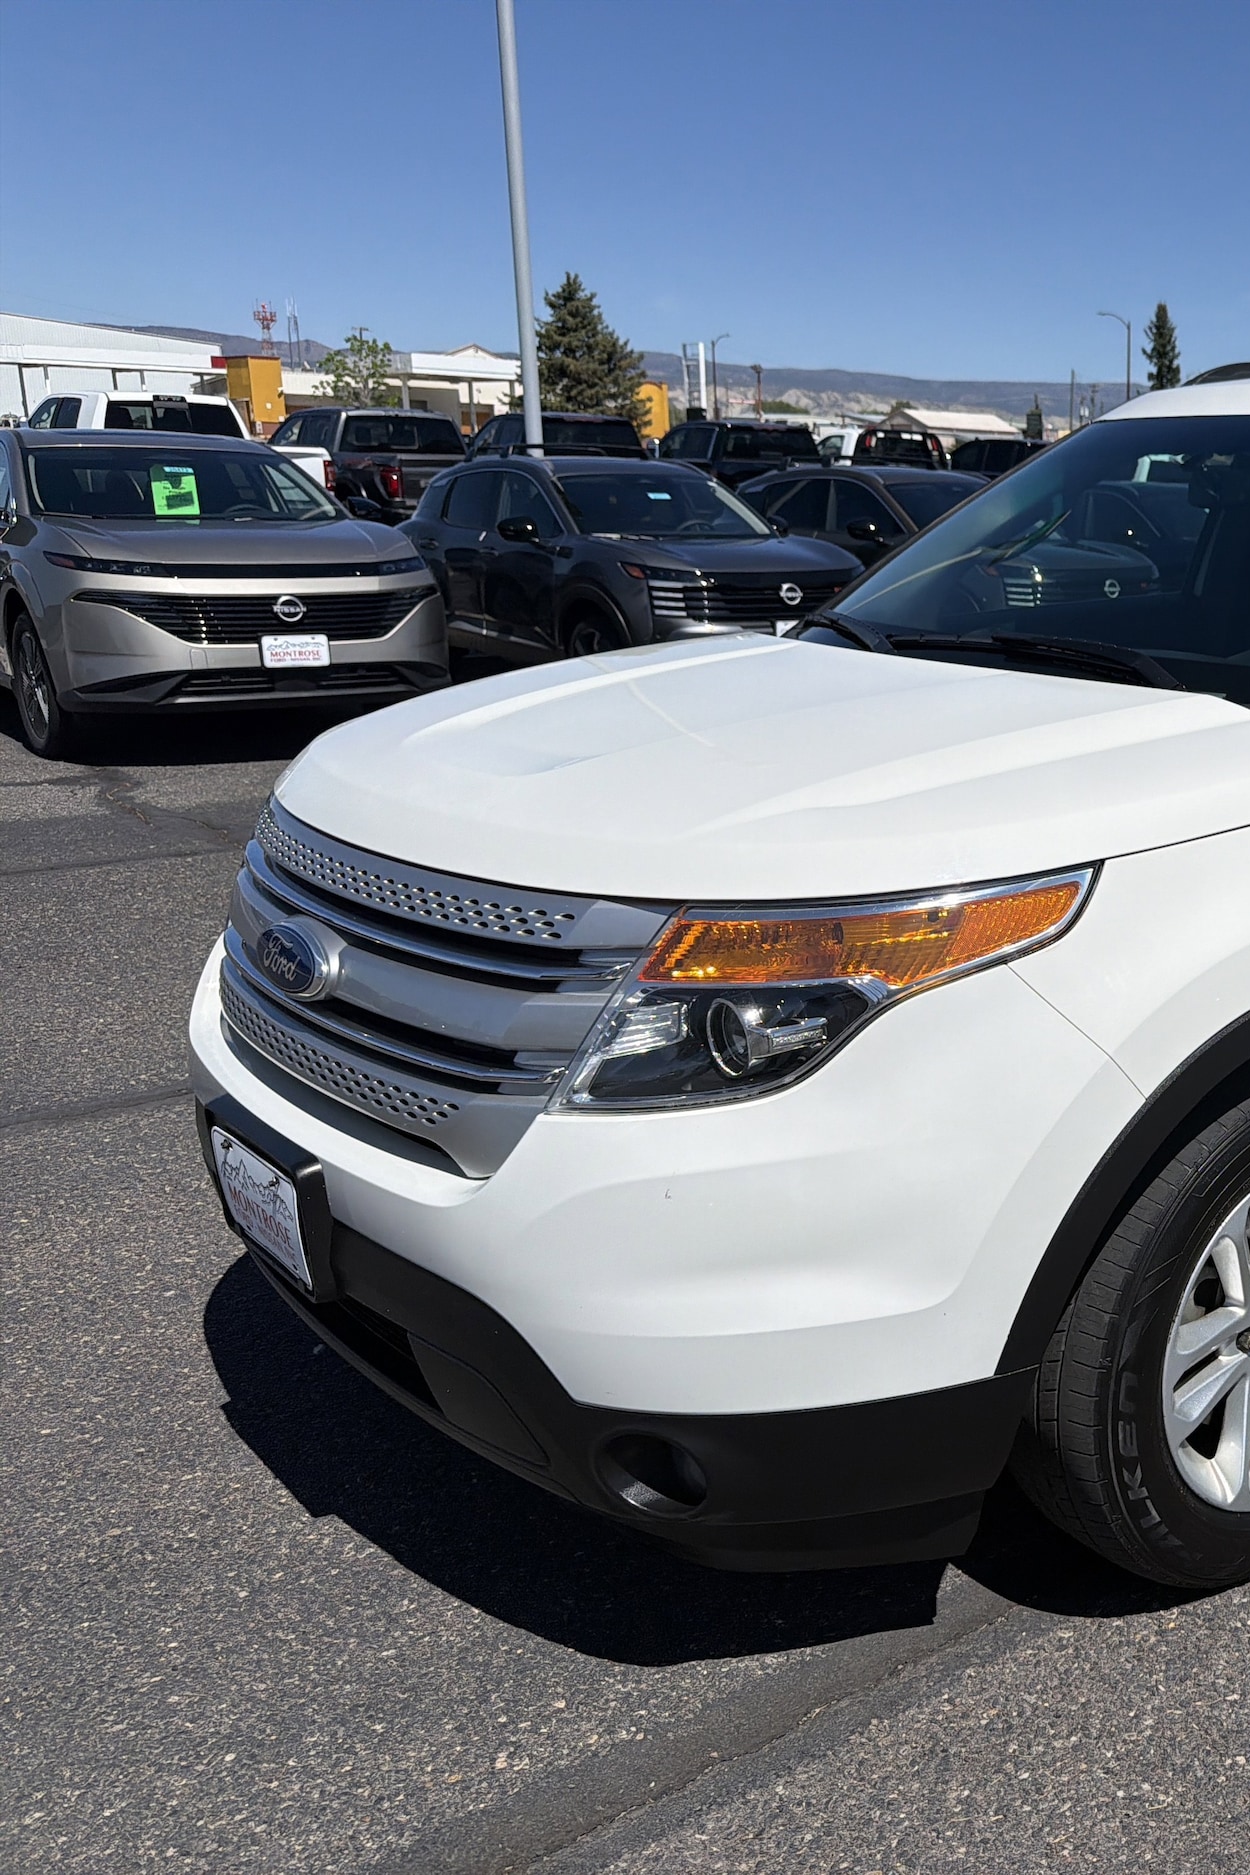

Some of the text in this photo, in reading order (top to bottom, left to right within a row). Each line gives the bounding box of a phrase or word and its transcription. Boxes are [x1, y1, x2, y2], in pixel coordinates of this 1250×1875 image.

[272, 605, 307, 613] NISSAN
[270, 649, 321, 658] MONTROSE
[263, 933, 301, 981] Ford
[228, 1181, 295, 1251] MONTROSE
[1118, 1371, 1187, 1562] ALKEN
